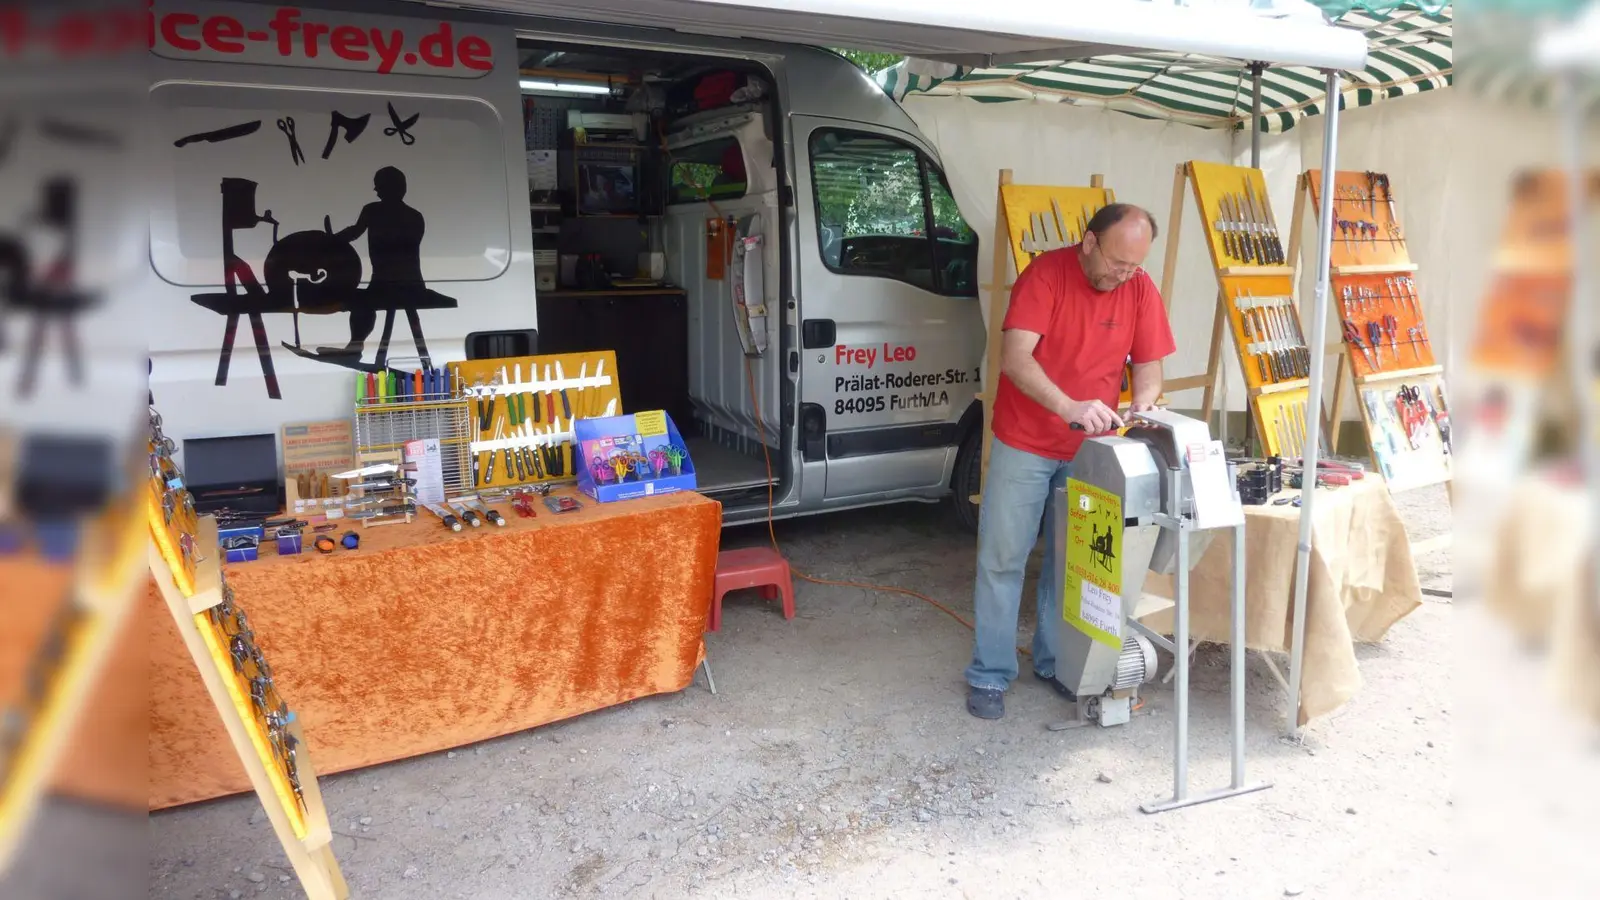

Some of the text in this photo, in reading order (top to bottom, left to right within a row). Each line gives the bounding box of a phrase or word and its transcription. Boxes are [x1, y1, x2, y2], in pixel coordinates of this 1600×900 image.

[835, 343, 917, 369] Frey Leo
[835, 369, 968, 392] Prälat-Roderer-Str.
[834, 391, 949, 415] 84095 Furth/LA
